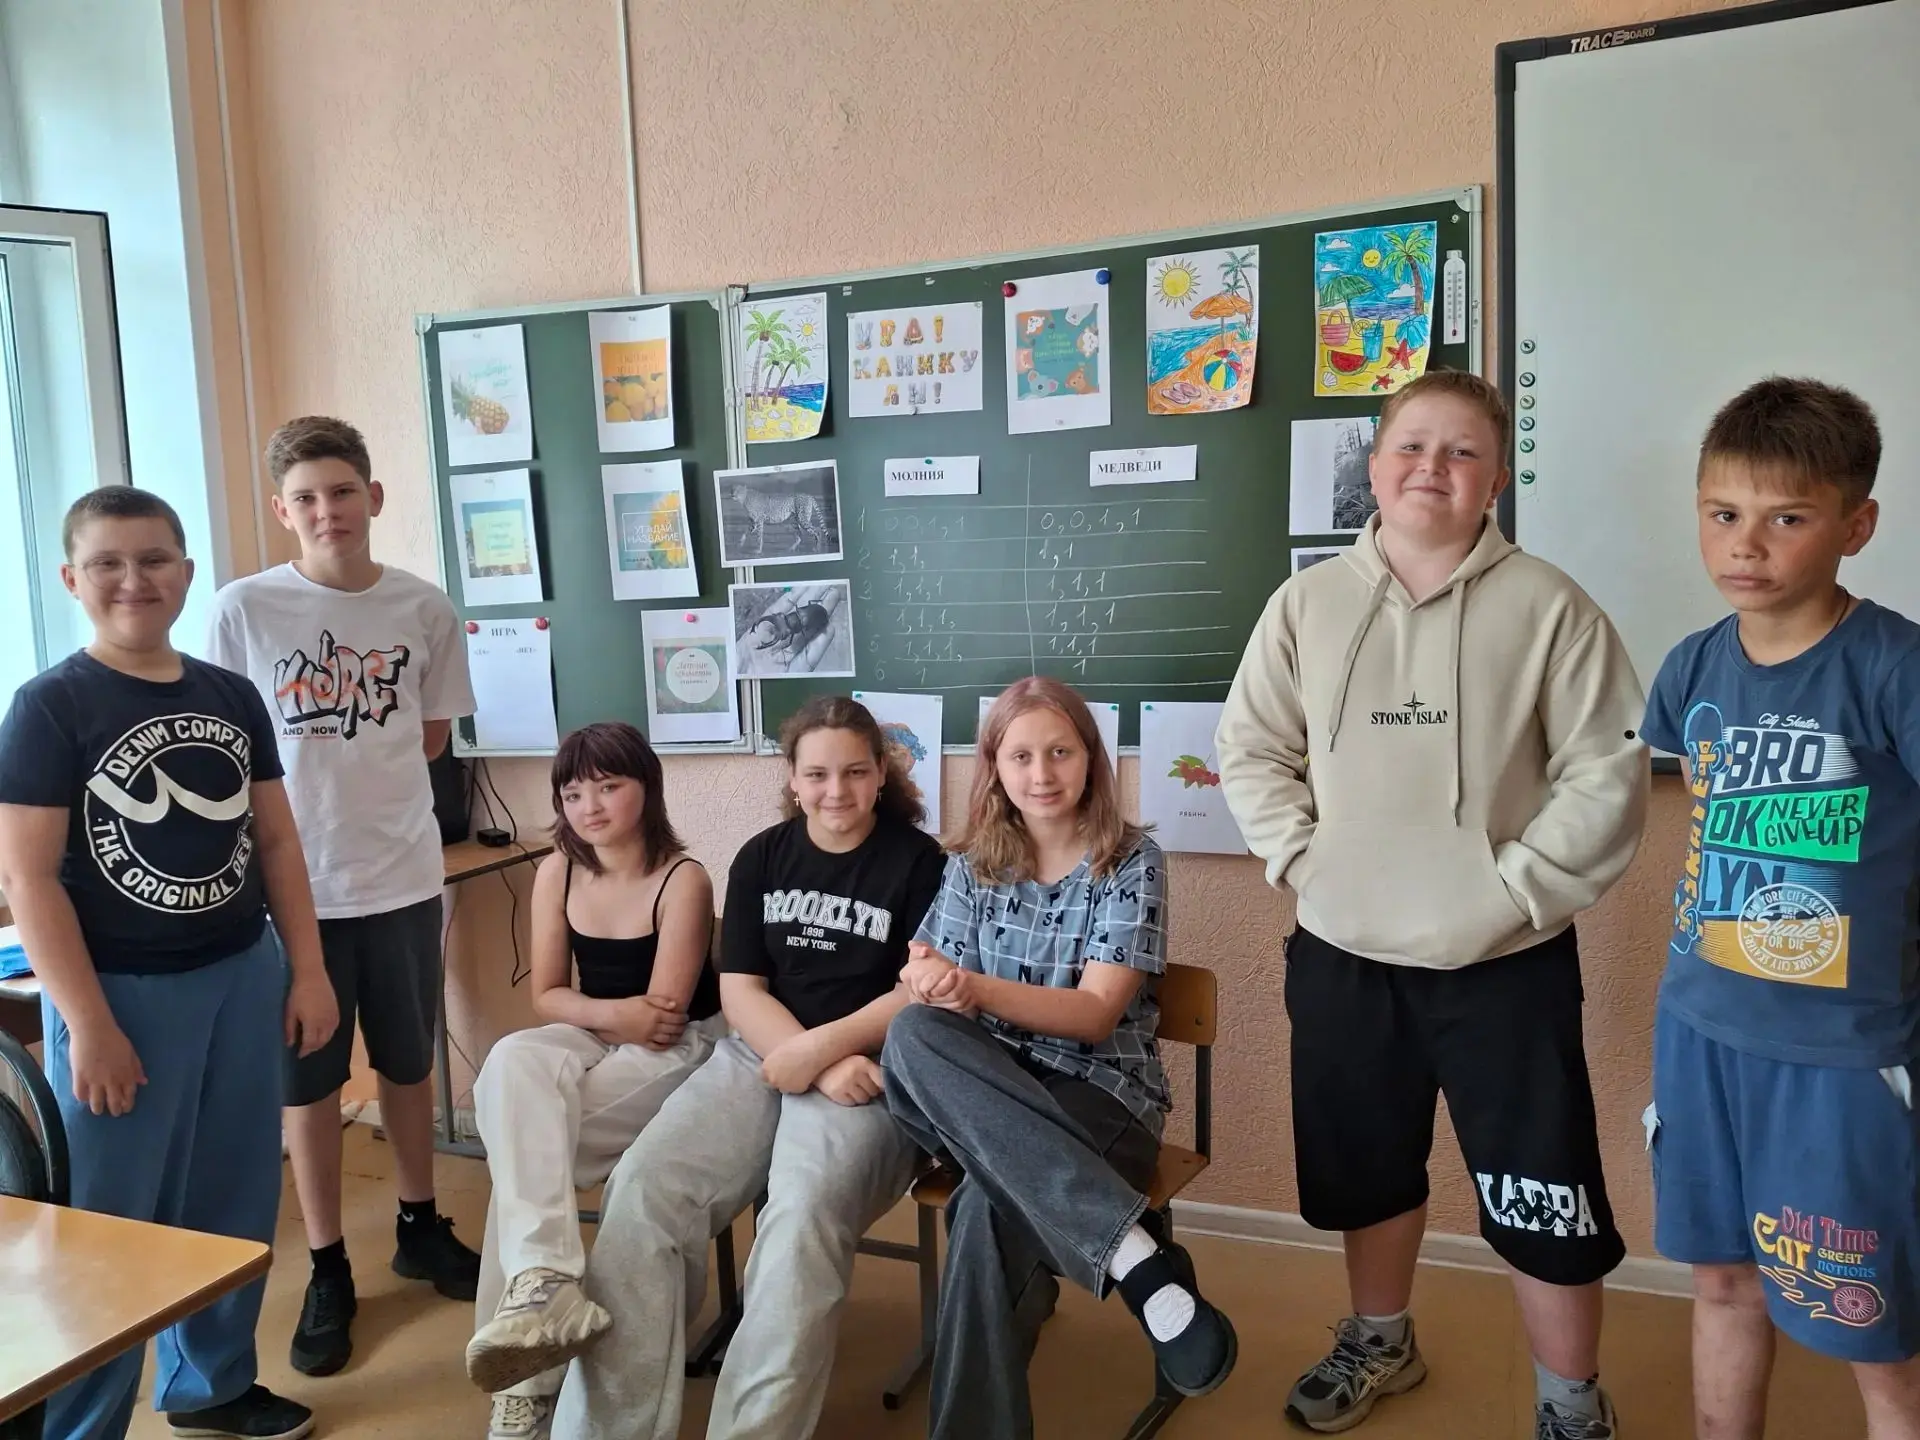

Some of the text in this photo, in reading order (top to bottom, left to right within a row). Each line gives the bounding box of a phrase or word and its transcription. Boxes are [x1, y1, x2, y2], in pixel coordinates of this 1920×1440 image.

[855, 314, 944, 350] УРА!
[853, 350, 978, 379] КАНИКУ
[891, 470, 944, 481] МОЛНИЯ
[1098, 460, 1162, 474] МЕДВЕДИ
[627, 532, 679, 544] НАЗВАНИЕ
[490, 627, 518, 637] ИГРА
[282, 726, 338, 736] AND NOW
[1371, 709, 1448, 725] STONE ISLAN
[105, 719, 251, 779] DENIM COMPAN
[1722, 729, 1826, 790] BRO
[1767, 793, 1860, 821] NEVER
[1707, 798, 1768, 848] OK
[1764, 816, 1863, 847] GIVE UP
[93, 821, 130, 869] THE
[121, 867, 234, 907] ORIGINAL
[1699, 853, 1786, 912] LYN
[786, 936, 837, 951] NEW YORK
[801, 926, 825, 938] 1898
[1781, 1205, 1879, 1253] Old Time
[1817, 1247, 1864, 1265] GREAT
